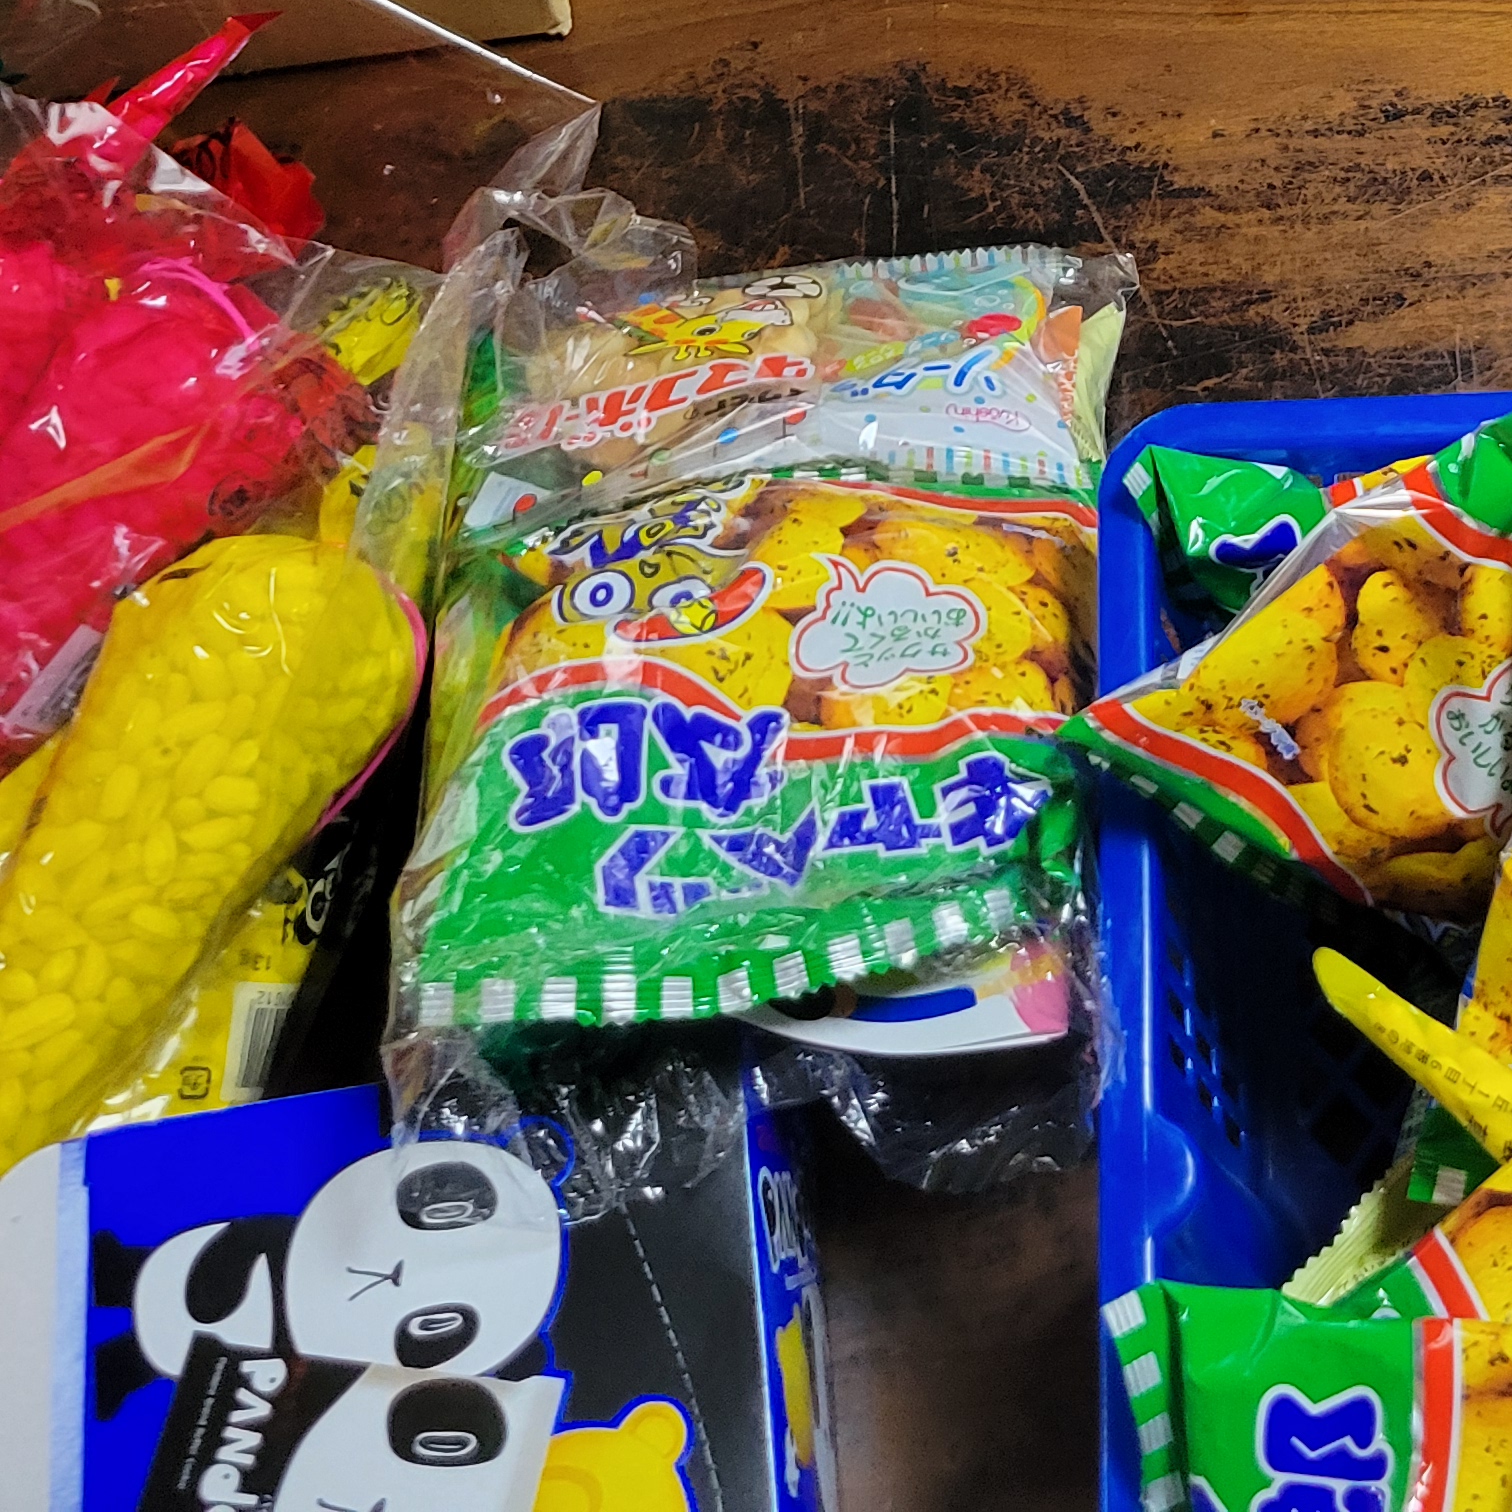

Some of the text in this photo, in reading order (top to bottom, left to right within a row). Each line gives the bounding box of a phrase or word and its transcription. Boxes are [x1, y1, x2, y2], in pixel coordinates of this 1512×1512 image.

[839, 626, 942, 654] かるくて
[853, 642, 950, 669] サクッと
